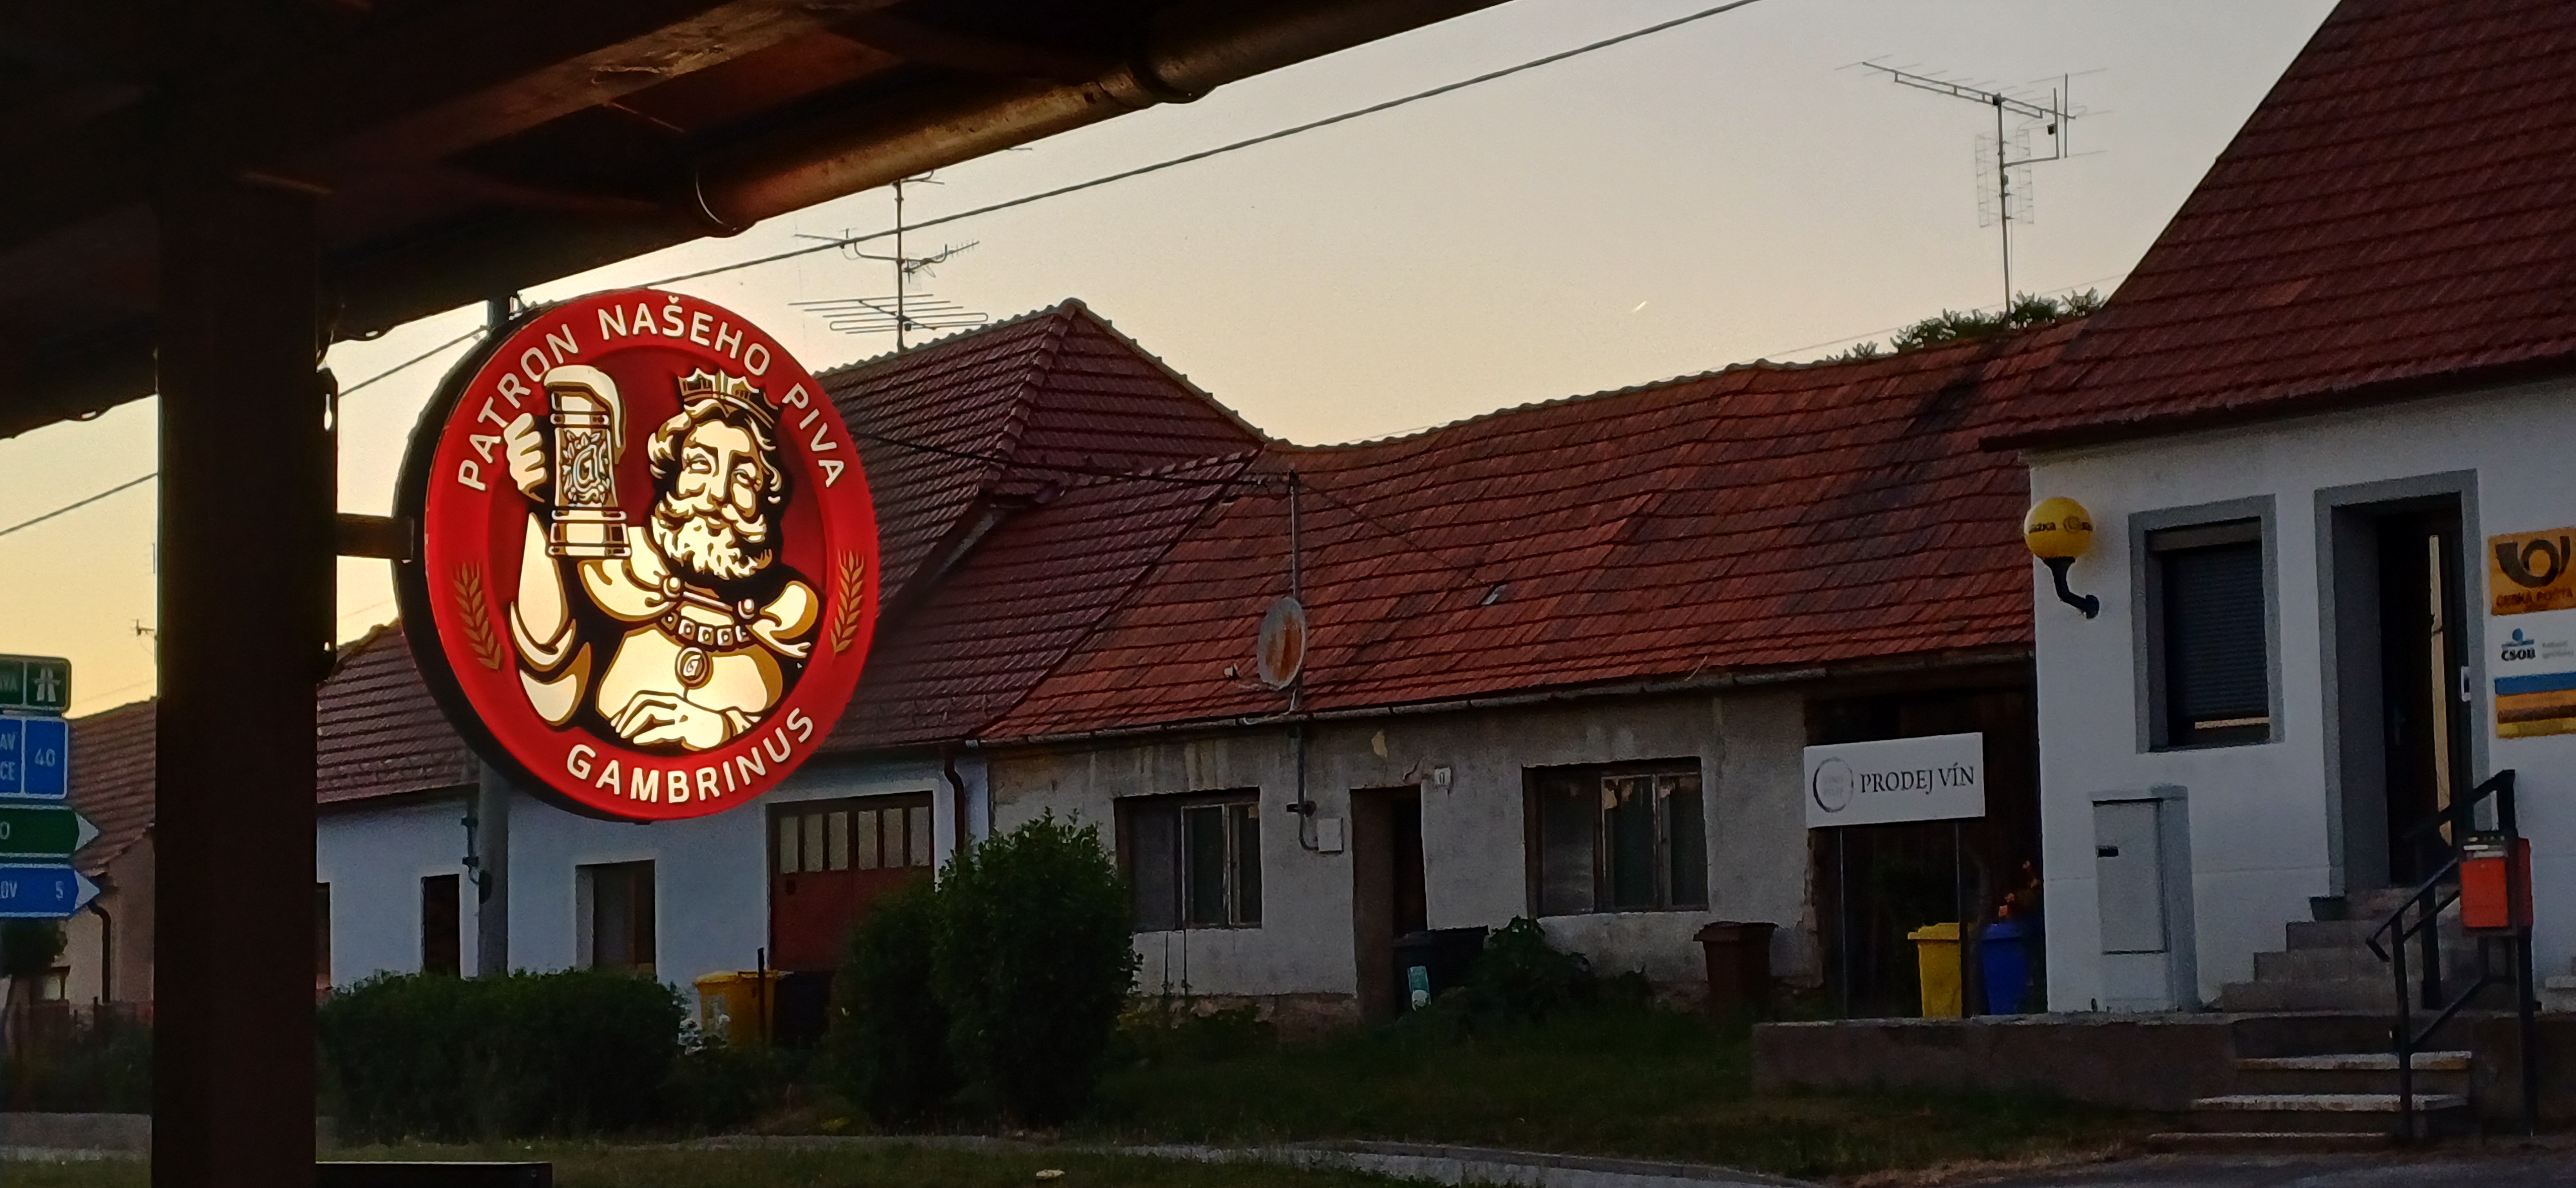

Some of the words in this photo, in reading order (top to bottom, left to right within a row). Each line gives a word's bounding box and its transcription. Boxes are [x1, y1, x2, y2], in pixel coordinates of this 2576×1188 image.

[457, 323, 581, 492] PATRON
[597, 294, 771, 376] NAŠEHO
[781, 381, 846, 488] PIVA
[34, 747, 56, 767] 40
[566, 706, 813, 803] GAMBRINUS
[1859, 769, 1933, 795] PRODEJ
[1937, 762, 1975, 787] VÍN
[0, 879, 17, 899] OV
[55, 880, 64, 901] 5
